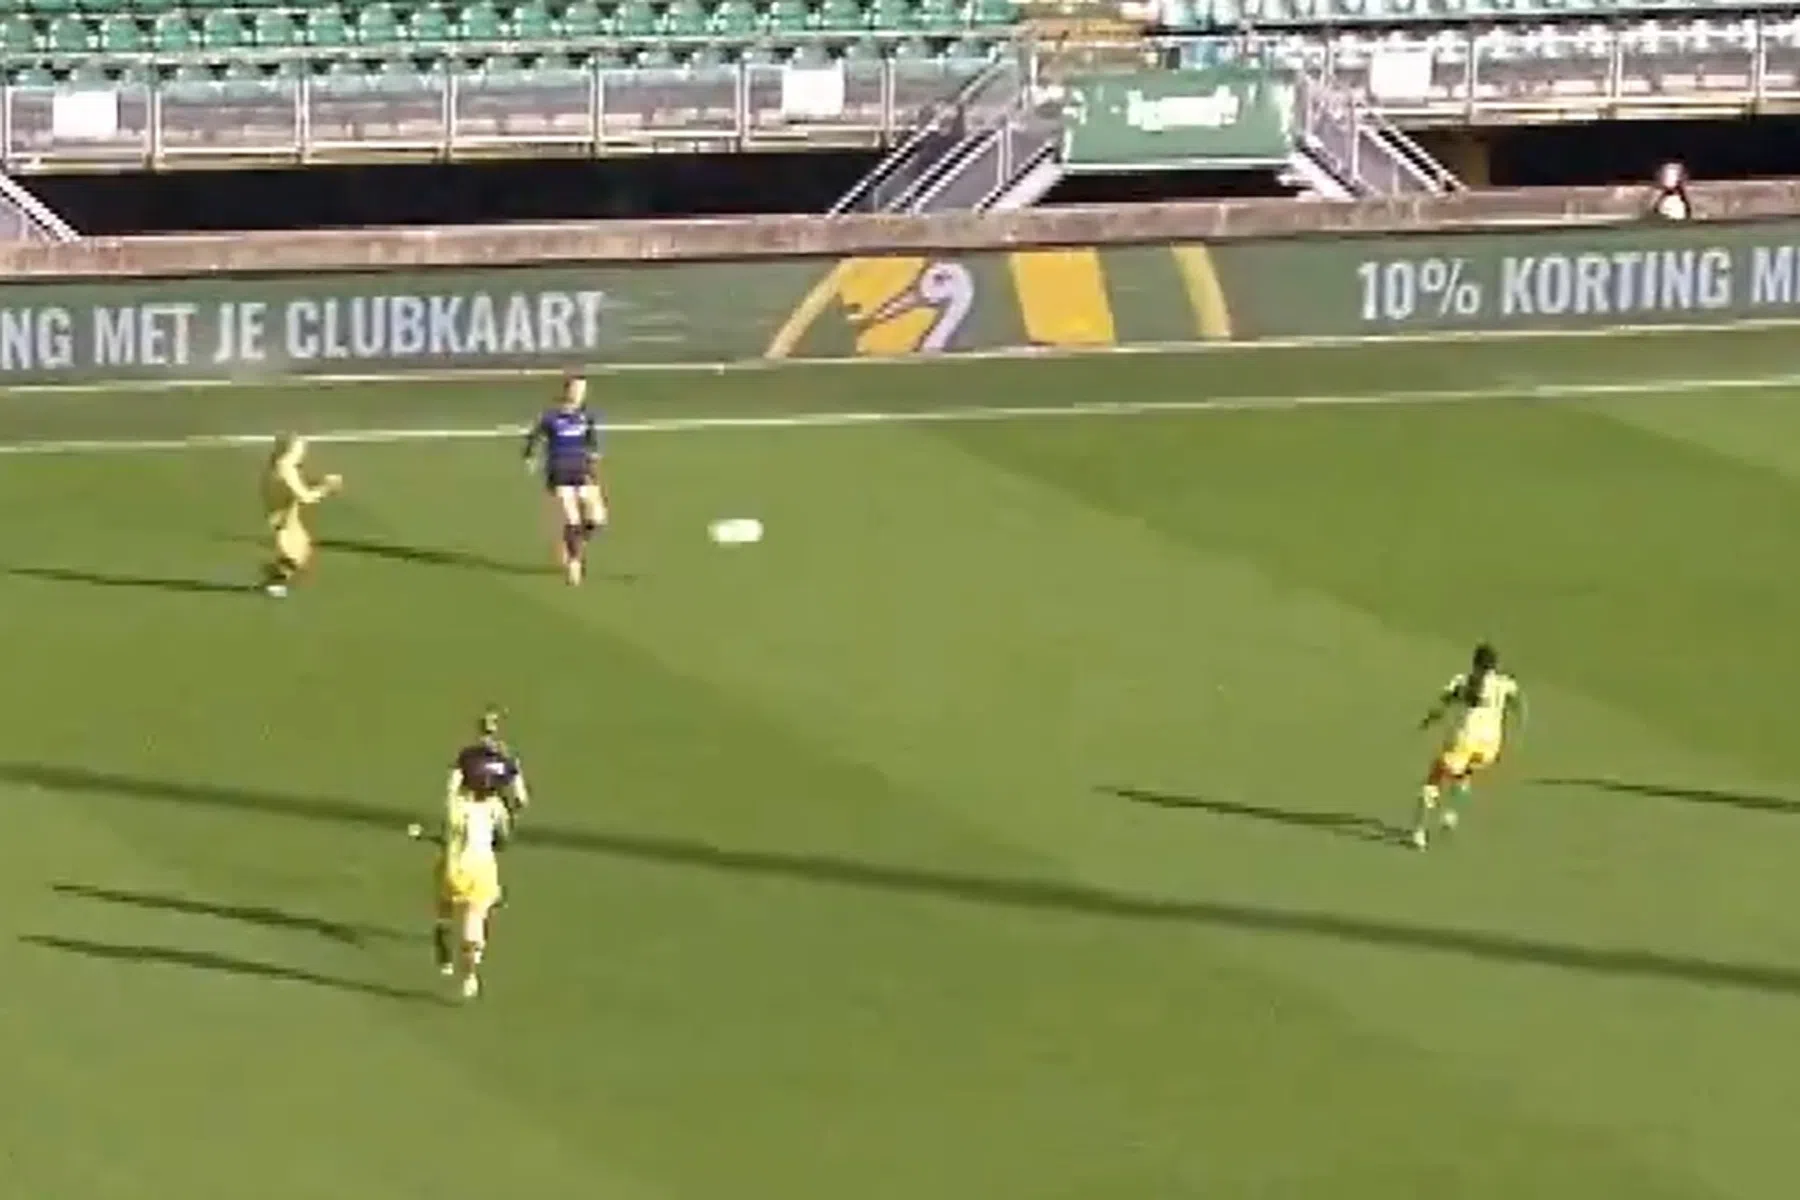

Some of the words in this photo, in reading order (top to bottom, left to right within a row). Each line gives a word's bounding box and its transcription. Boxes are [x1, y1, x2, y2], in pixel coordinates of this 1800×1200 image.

[1357, 258, 1481, 321] 10%
[1503, 246, 1733, 315] KORTING
[1, 308, 72, 371] NG
[93, 303, 196, 366] MET
[212, 302, 267, 362] JE
[285, 291, 604, 358] CLUBKAART
